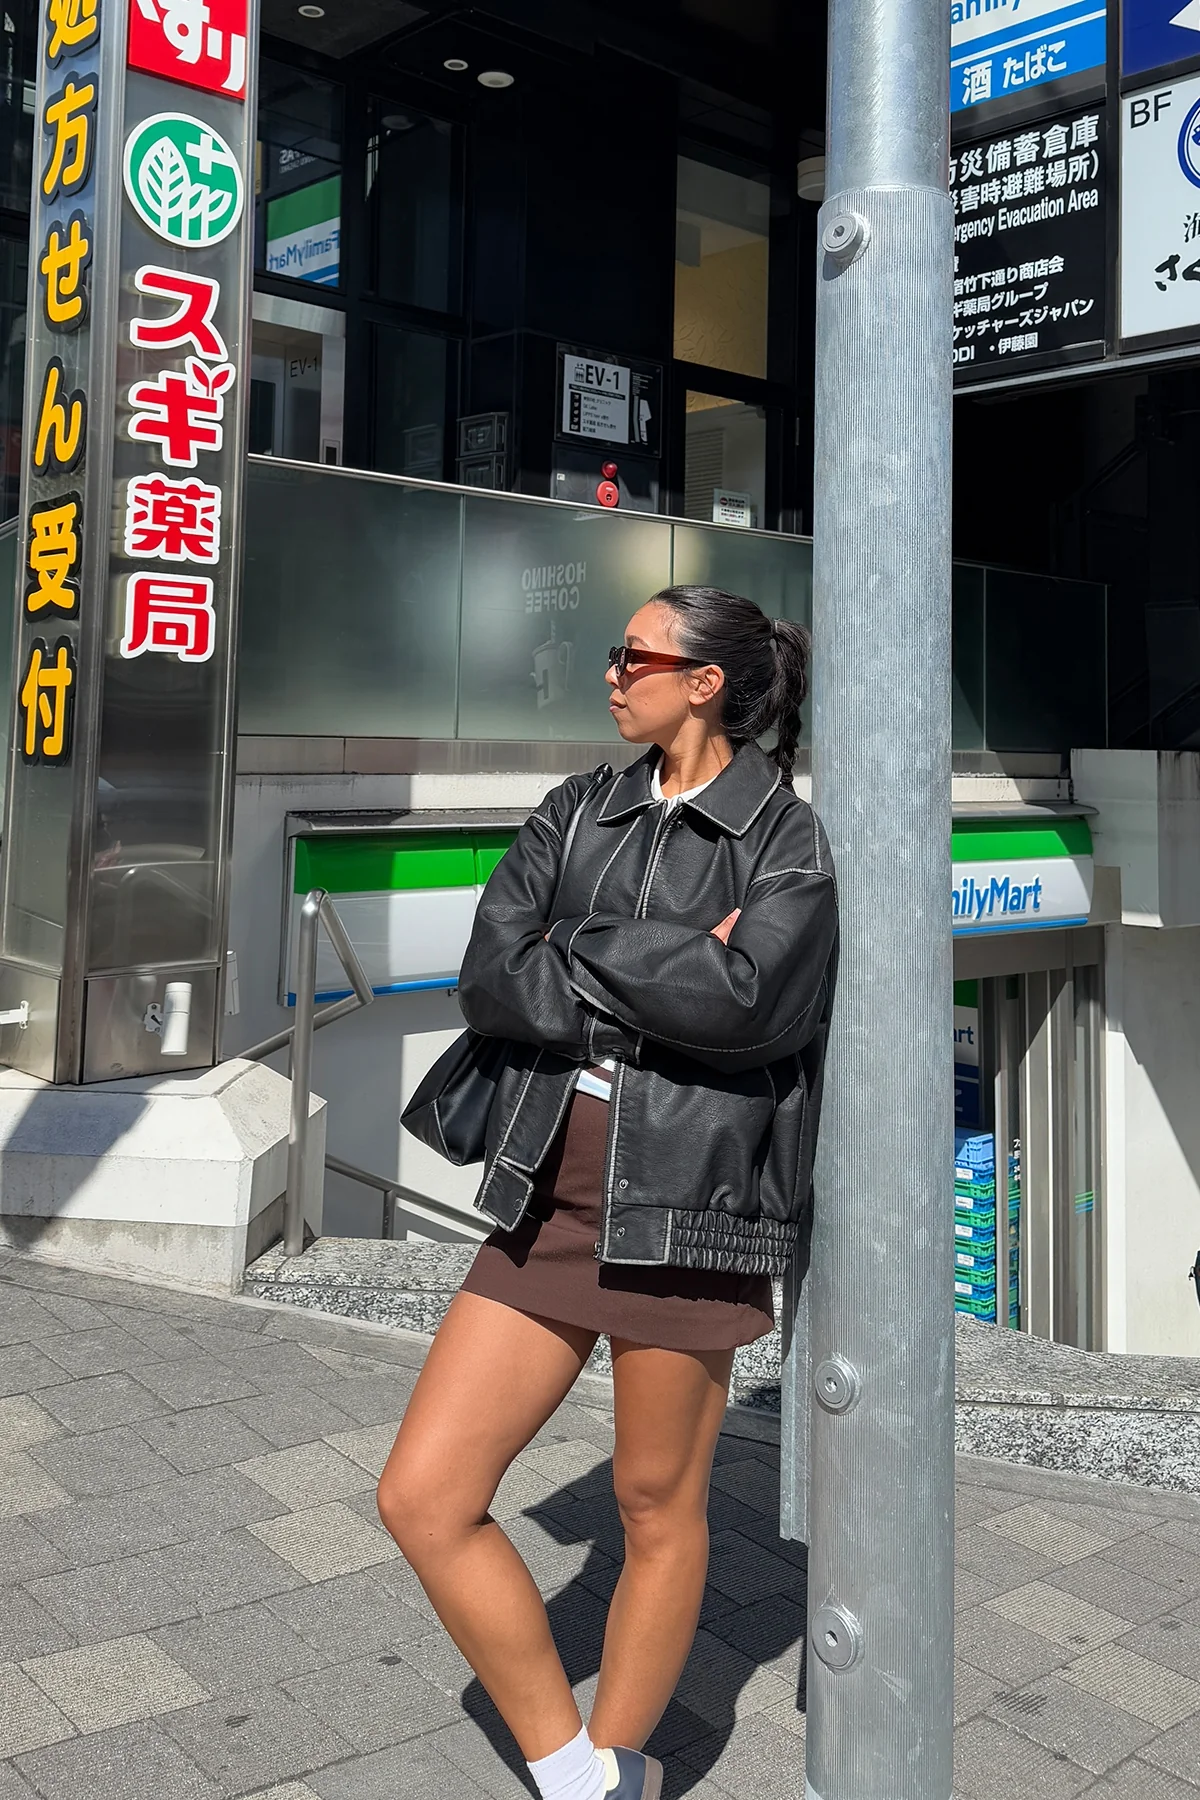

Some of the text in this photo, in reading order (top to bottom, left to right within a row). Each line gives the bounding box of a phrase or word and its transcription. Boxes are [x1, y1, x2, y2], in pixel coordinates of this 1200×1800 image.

[962, 40, 1066, 105] 酒 たばこ
[1130, 91, 1172, 129] BF
[998, 197, 1064, 230] Evacuation
[1067, 188, 1099, 213] Area
[290, 355, 318, 378] EV-1
[585, 364, 620, 390] EV-1
[120, 265, 236, 662] スギ薬局
